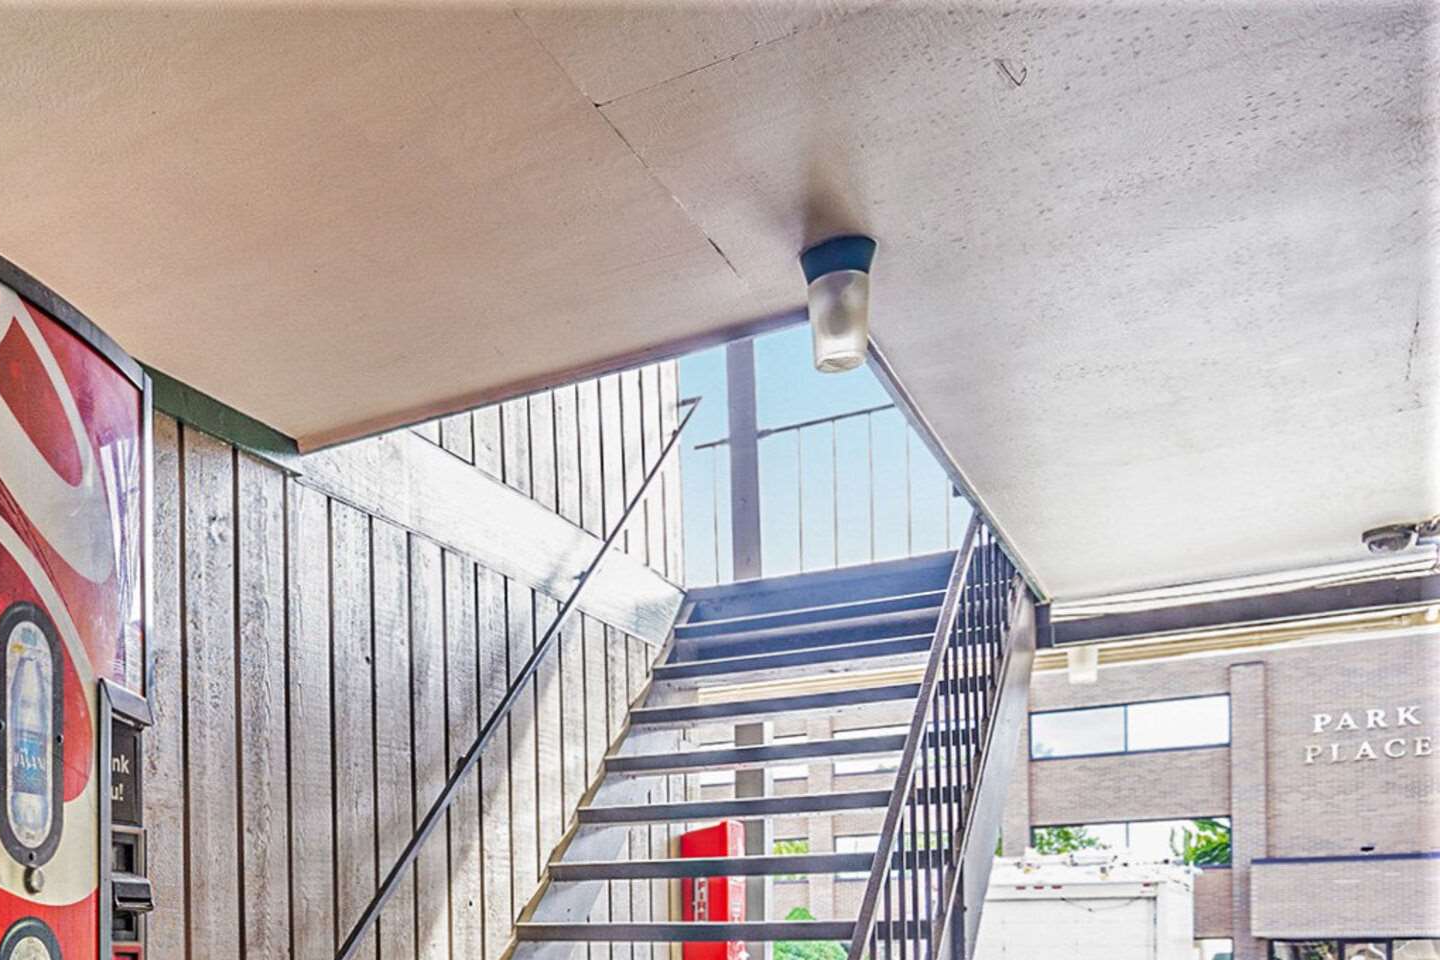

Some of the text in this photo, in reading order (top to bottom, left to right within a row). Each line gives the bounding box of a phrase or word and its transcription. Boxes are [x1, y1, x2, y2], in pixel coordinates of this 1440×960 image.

[1312, 705, 1422, 733] PARK
[111, 753, 130, 775] nk
[1304, 736, 1433, 765] PLACE
